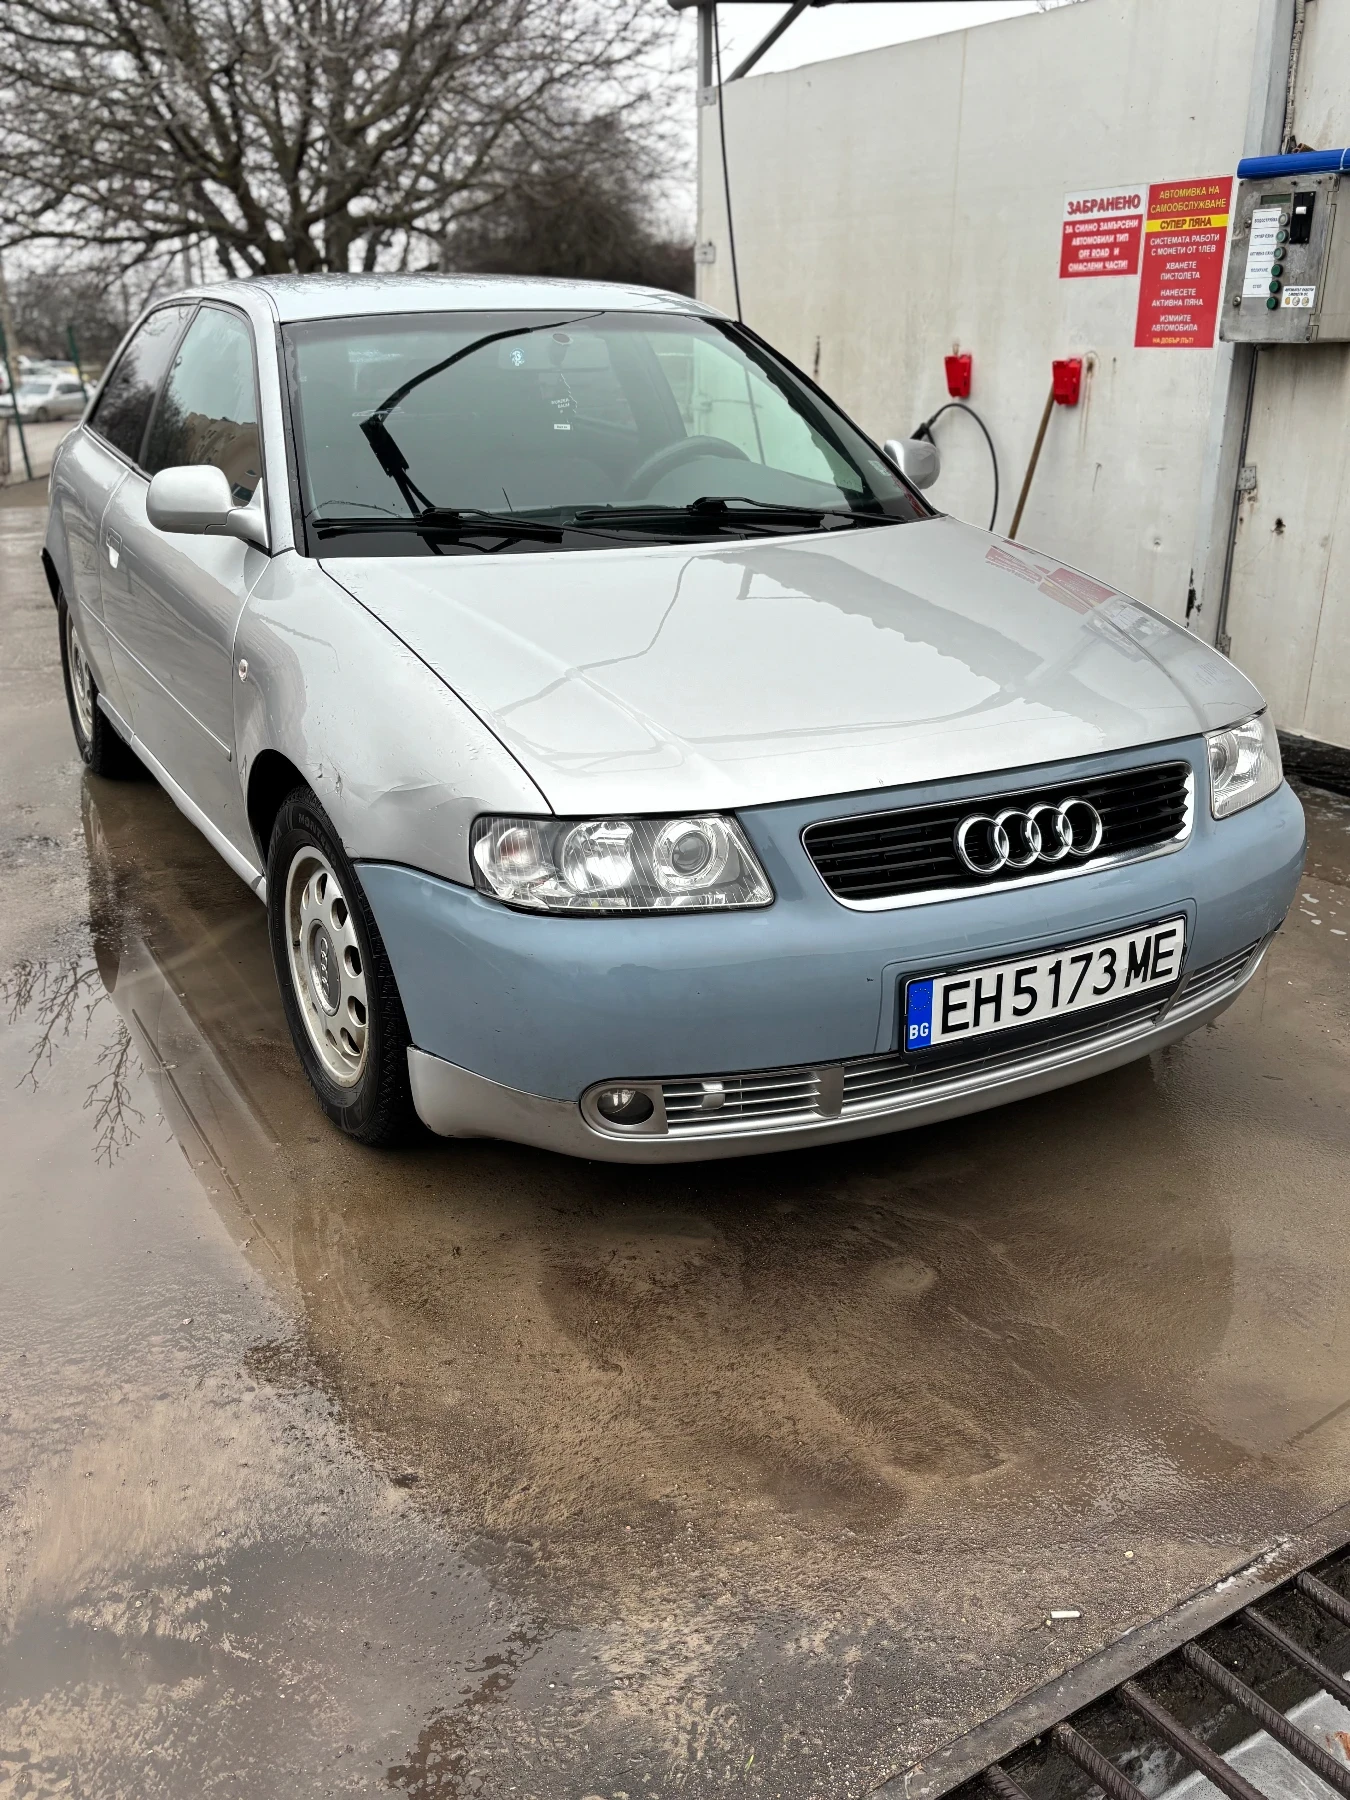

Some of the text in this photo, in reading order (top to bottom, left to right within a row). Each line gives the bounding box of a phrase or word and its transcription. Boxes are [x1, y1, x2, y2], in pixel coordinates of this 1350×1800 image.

[1160, 186, 1219, 199] АВТОМИВКА НА
[1067, 194, 1141, 215] ЗАБРАНЕНО
[1151, 198, 1226, 213] САМООБСЛУЖВАНЕ
[1065, 219, 1139, 234] ЗА СИЛНО ЗАМЪРСЕНИ
[1160, 217, 1212, 230] СУПЕР ПЯНА
[1072, 233, 1129, 246] АВТОМОБИЛИ ТИП
[1150, 234, 1219, 245] СИСТЕМАТА РАБОТИ
[1078, 249, 1090, 258] OFF
[1092, 248, 1109, 257] ROAD
[1151, 248, 1156, 256] С
[1158, 246, 1185, 255] МОНЕТИ
[1068, 260, 1128, 272] ОМАСЛЕНИ ЧАСТИ!
[1166, 261, 1197, 270] ХВАНЕТЕ
[1161, 272, 1200, 280] ПИСТОЛЕТА
[1161, 288, 1196, 296] НАНЕСЕТЕ
[1152, 299, 1182, 307] АКТИВНА
[1160, 314, 1191, 322] ИЗМИЙТЕ
[909, 1022, 929, 1040] BG
